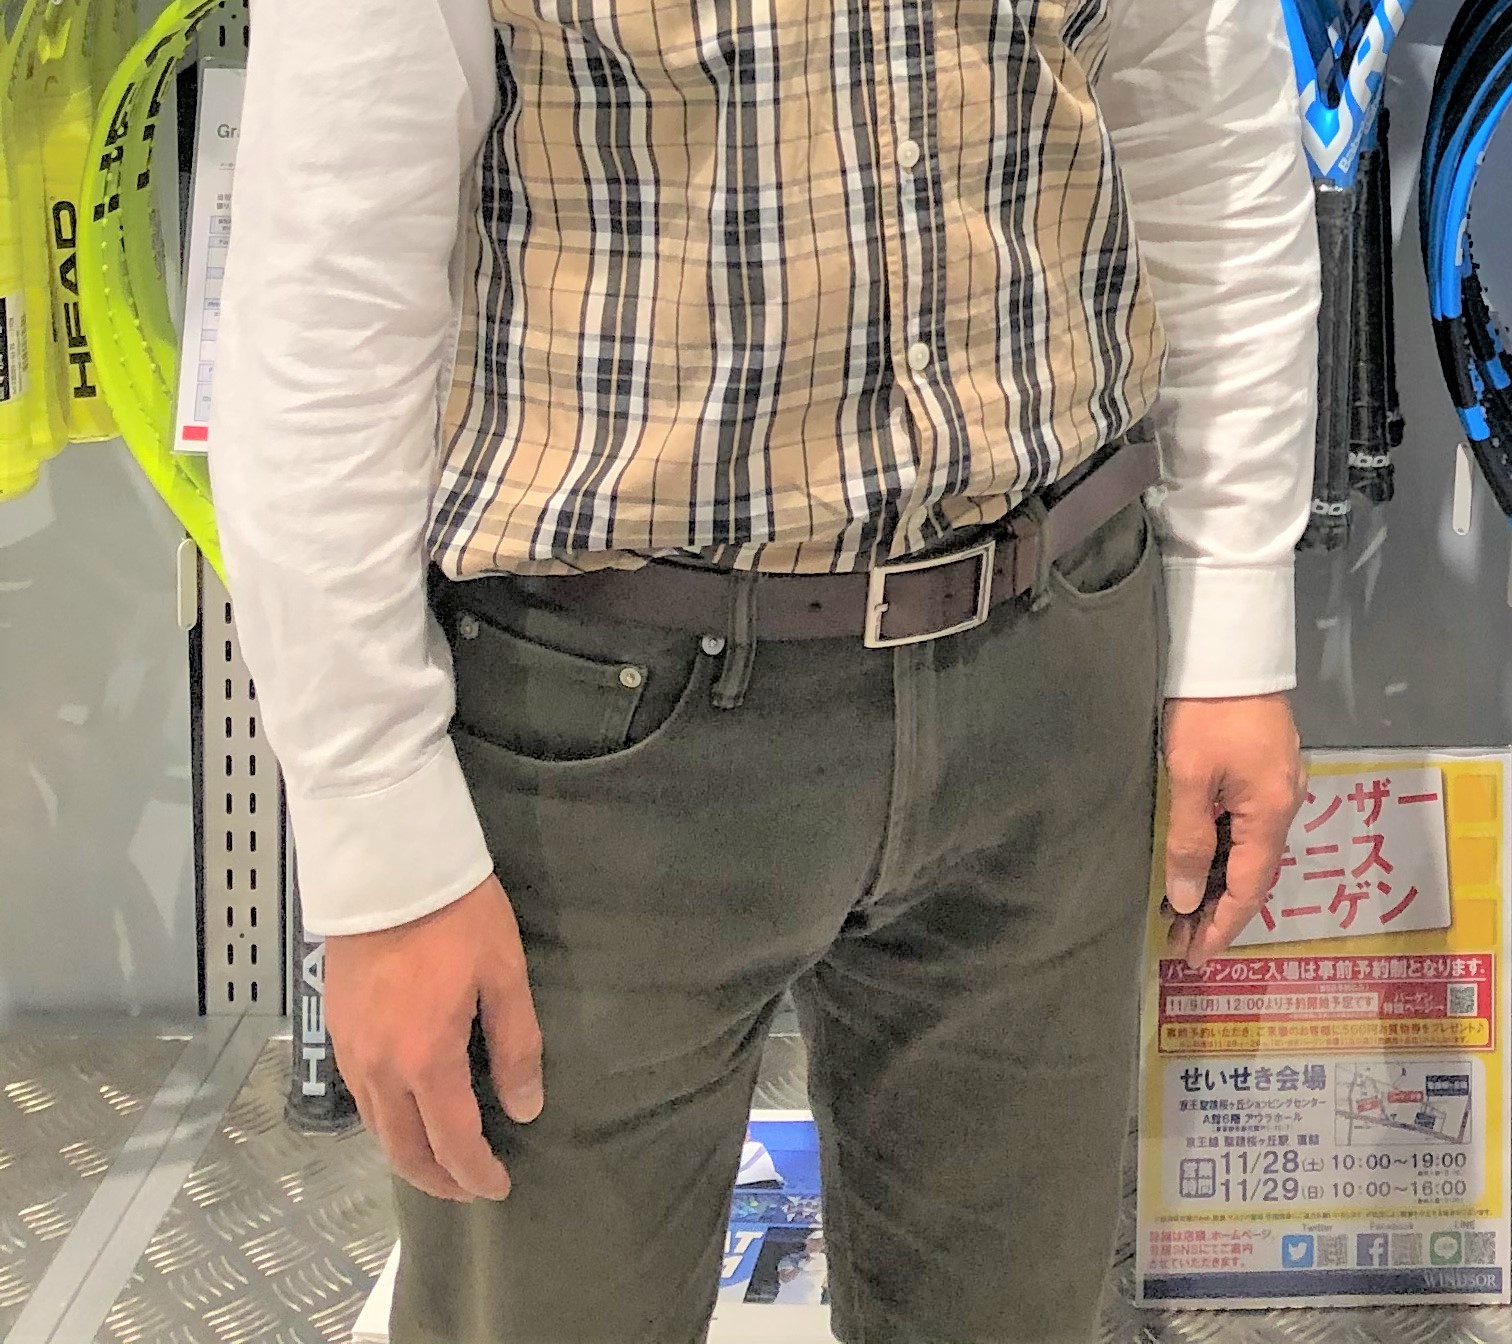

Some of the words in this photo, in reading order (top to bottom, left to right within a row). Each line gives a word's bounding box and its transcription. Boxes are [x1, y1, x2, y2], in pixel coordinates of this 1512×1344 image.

[1305, 778, 1438, 833] ンザー
[303, 943, 325, 1096] HEA
[1180, 1064, 1326, 1092] せいせき会場
